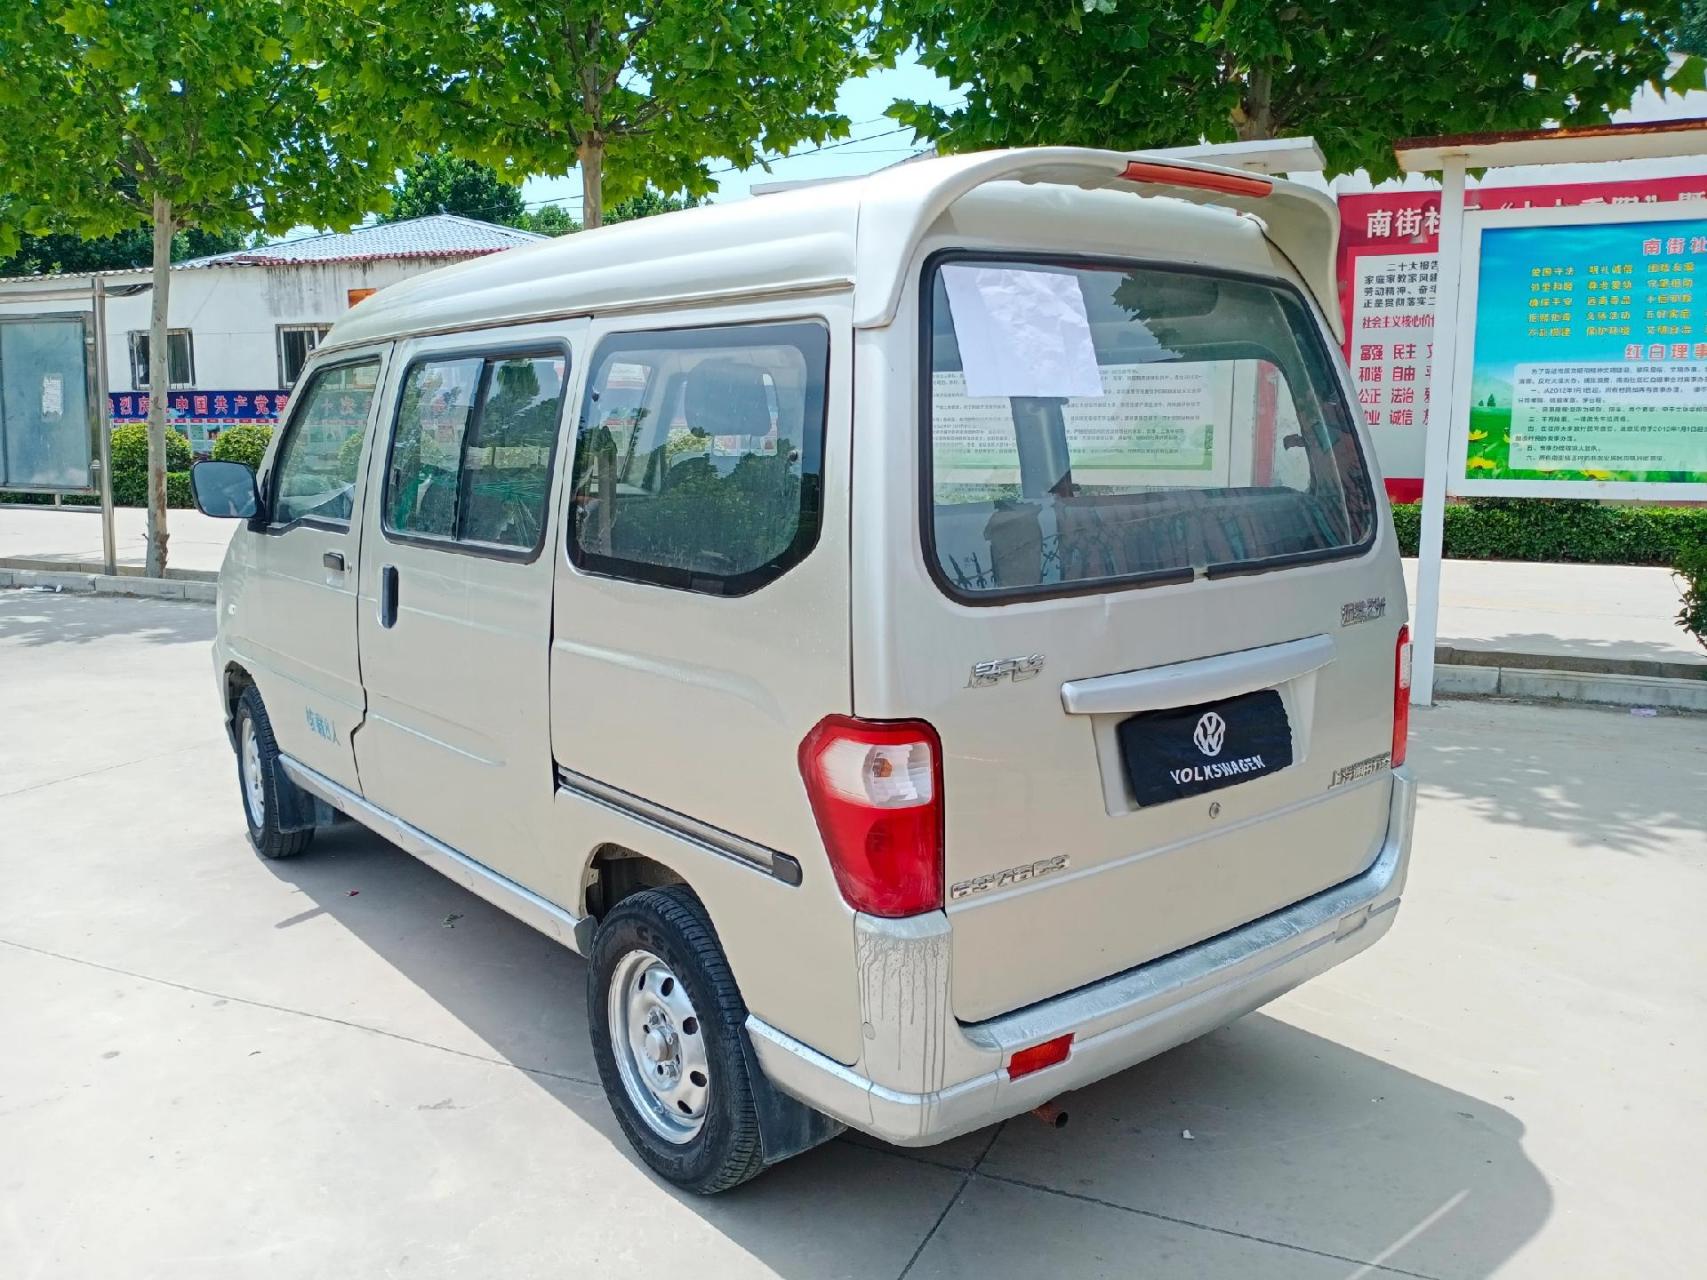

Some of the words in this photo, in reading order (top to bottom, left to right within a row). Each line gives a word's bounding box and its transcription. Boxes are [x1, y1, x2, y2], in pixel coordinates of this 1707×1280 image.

[1360, 344, 1383, 361] 富强
[1393, 343, 1416, 360] 民主
[1359, 366, 1383, 382] 和谐
[1392, 365, 1415, 381] 自由
[1358, 388, 1382, 404] 公正
[1390, 387, 1414, 404] 法治
[1364, 409, 1380, 425] 业
[1389, 409, 1413, 426] 诚信
[1169, 754, 1266, 785] VOLKSWAGEN
